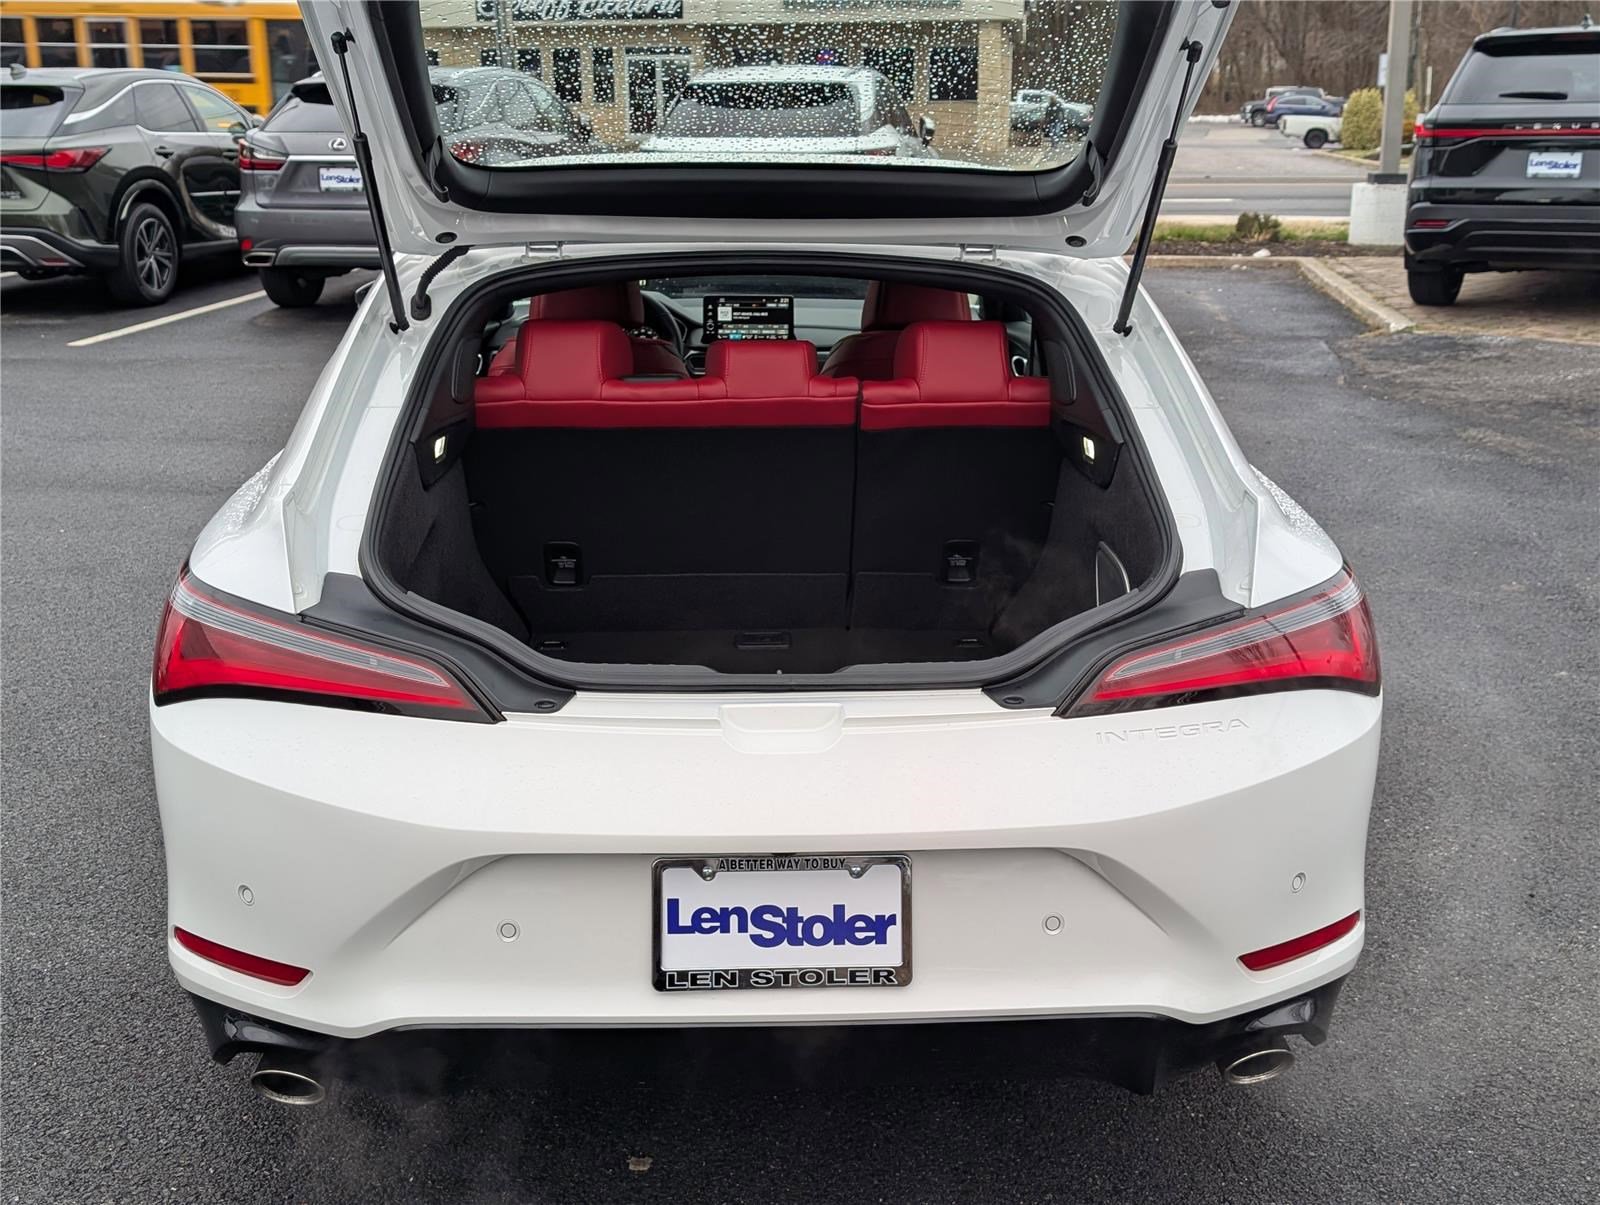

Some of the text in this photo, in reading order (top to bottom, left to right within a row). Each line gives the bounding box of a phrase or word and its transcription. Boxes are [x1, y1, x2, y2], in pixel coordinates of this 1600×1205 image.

[1096, 718, 1250, 744] INTEGRA
[718, 857, 846, 870] A BETTER WAY TO BUY
[666, 968, 898, 989] LEN STOLER
